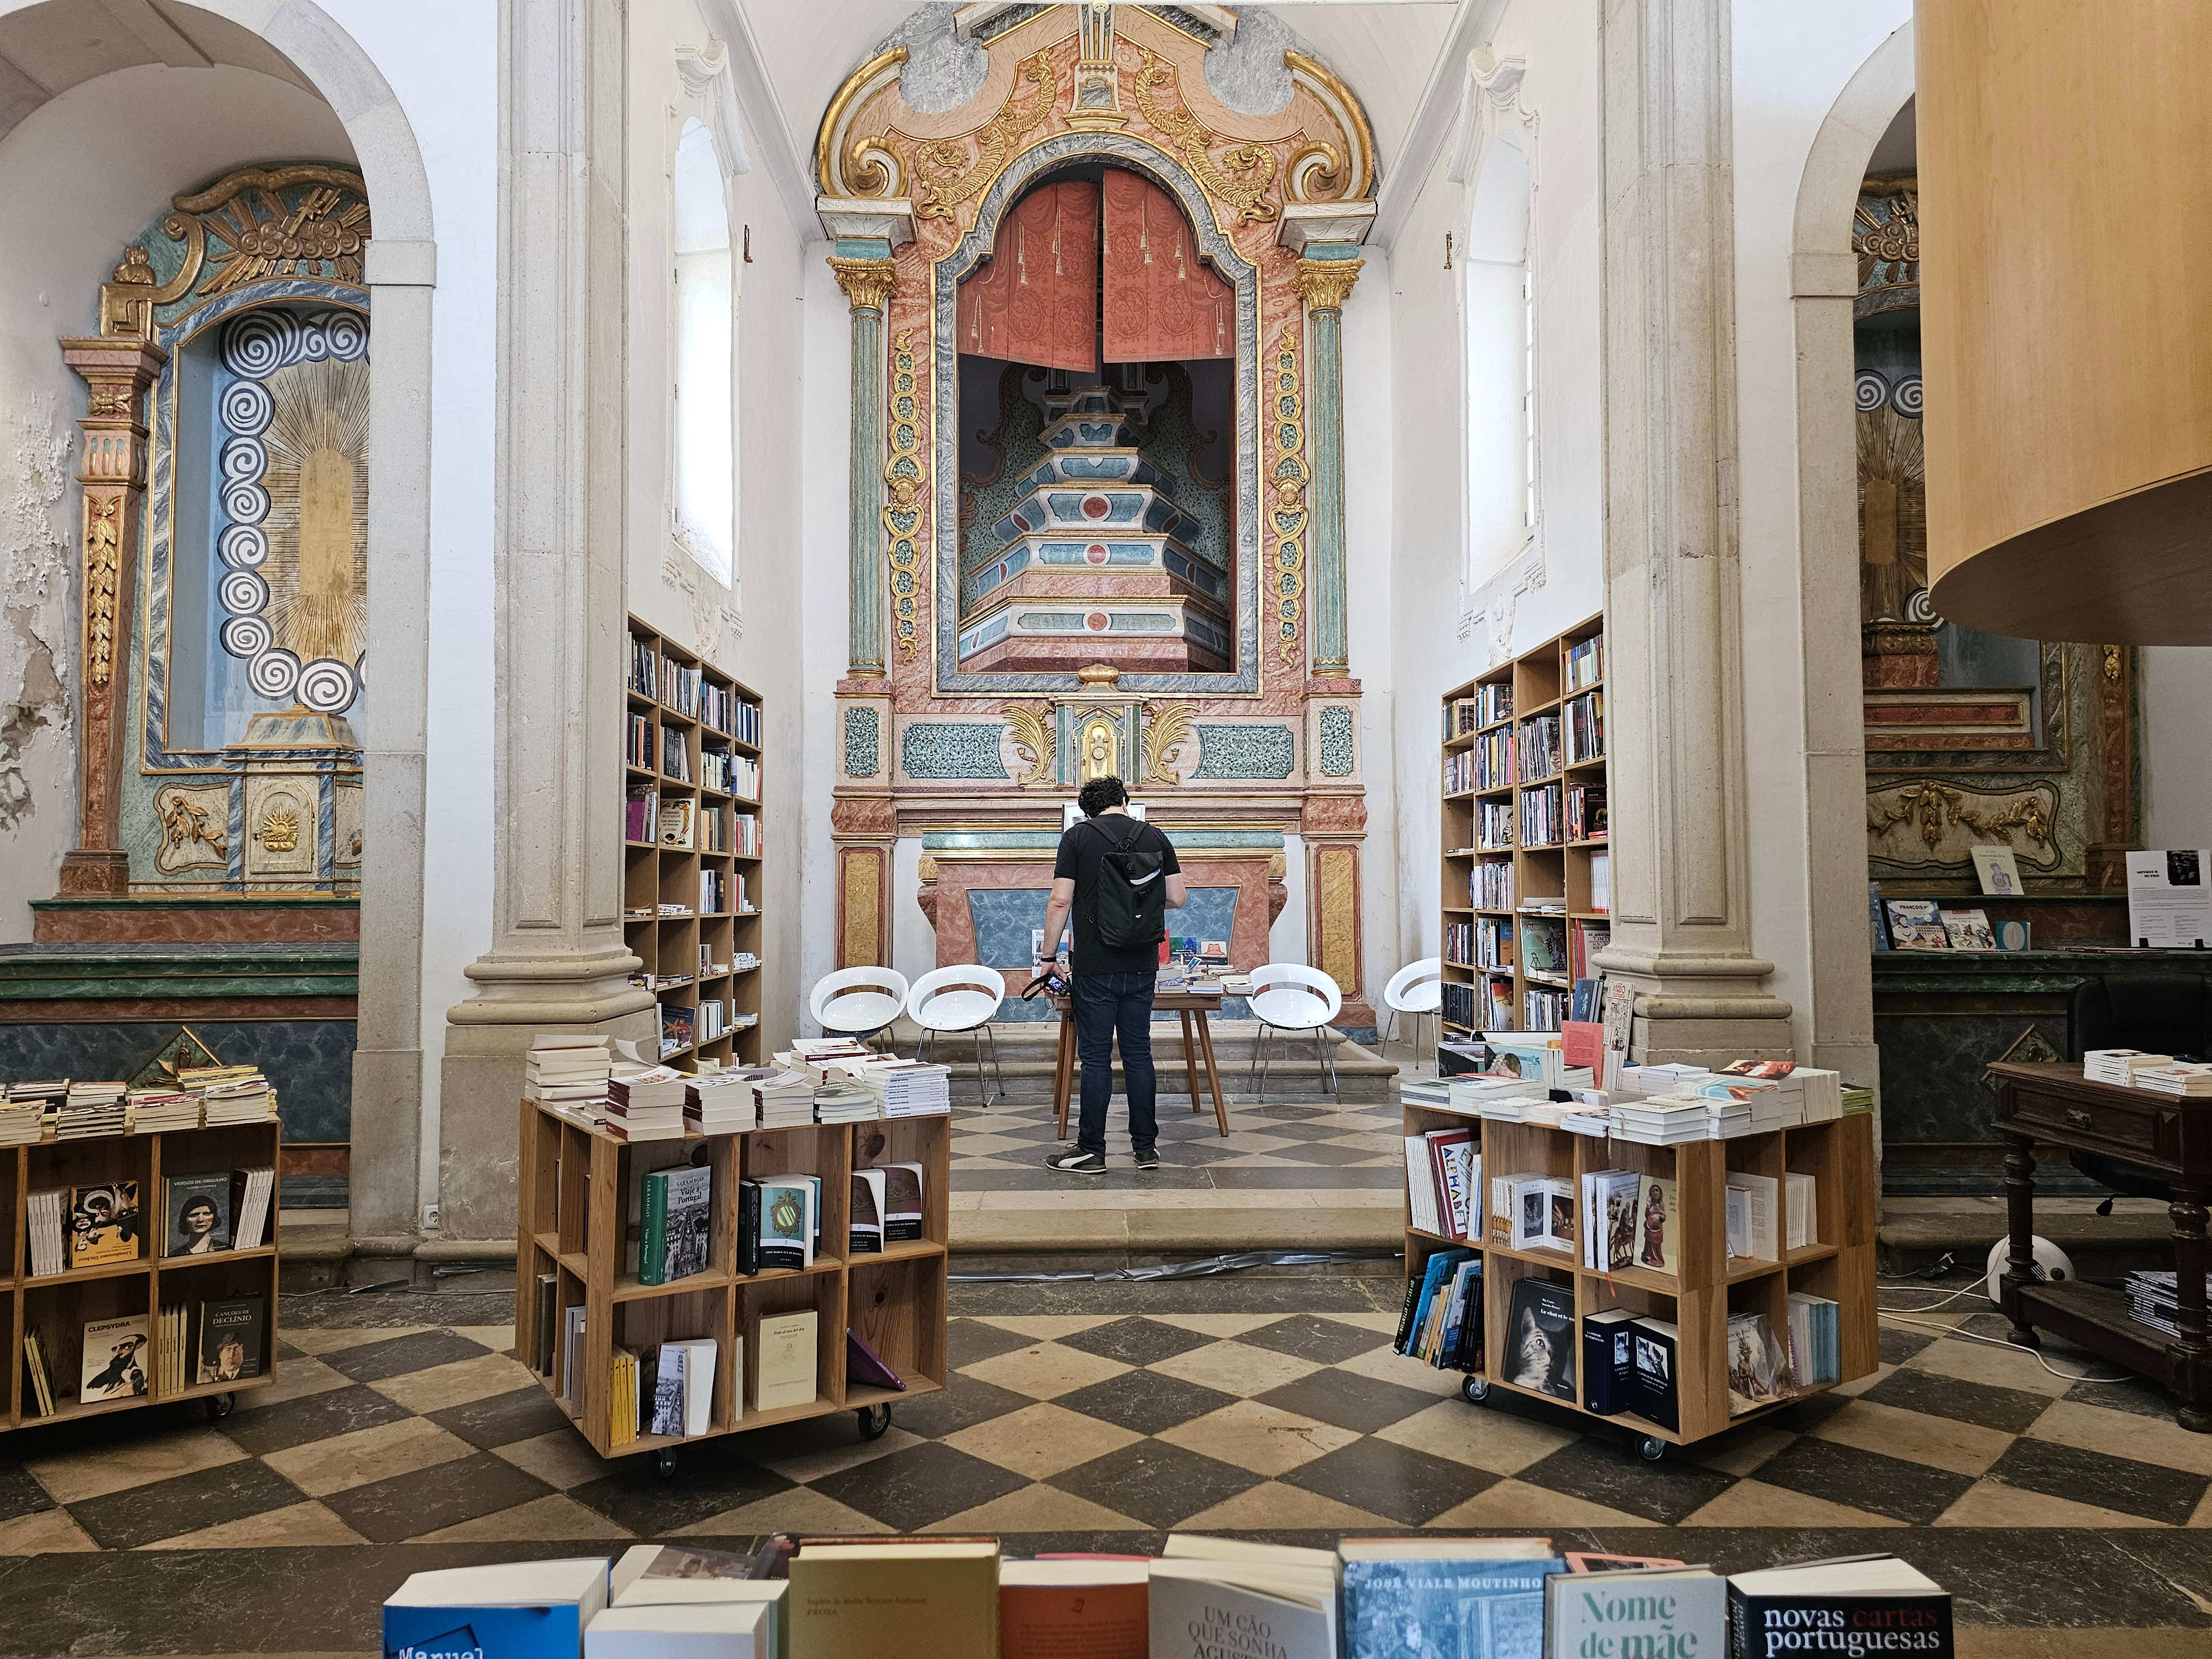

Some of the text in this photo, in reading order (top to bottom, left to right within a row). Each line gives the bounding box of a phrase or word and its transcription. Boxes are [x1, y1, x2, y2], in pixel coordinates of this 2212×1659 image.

[676, 1176, 705, 1187] SARAMAGO
[680, 1187, 696, 1196] Viaje
[678, 1193, 702, 1205] Portugal
[213, 1314, 252, 1324] DECLÍNIO
[88, 1321, 131, 1332] CLEPSYDRA
[1365, 1576, 1542, 1590] JOSÉ VIALE MOUTINHO
[1580, 1591, 1677, 1624] Nome
[1204, 1605, 1271, 1639] UM CÃO
[1764, 1606, 1937, 1628] novas cartas
[1188, 1620, 1288, 1659] QUE SONHA
[1579, 1631, 1614, 1659] de
[1620, 1624, 1698, 1659] mãe
[1764, 1629, 1940, 1658] portuguesas
[399, 1647, 484, 1659] Manuel
